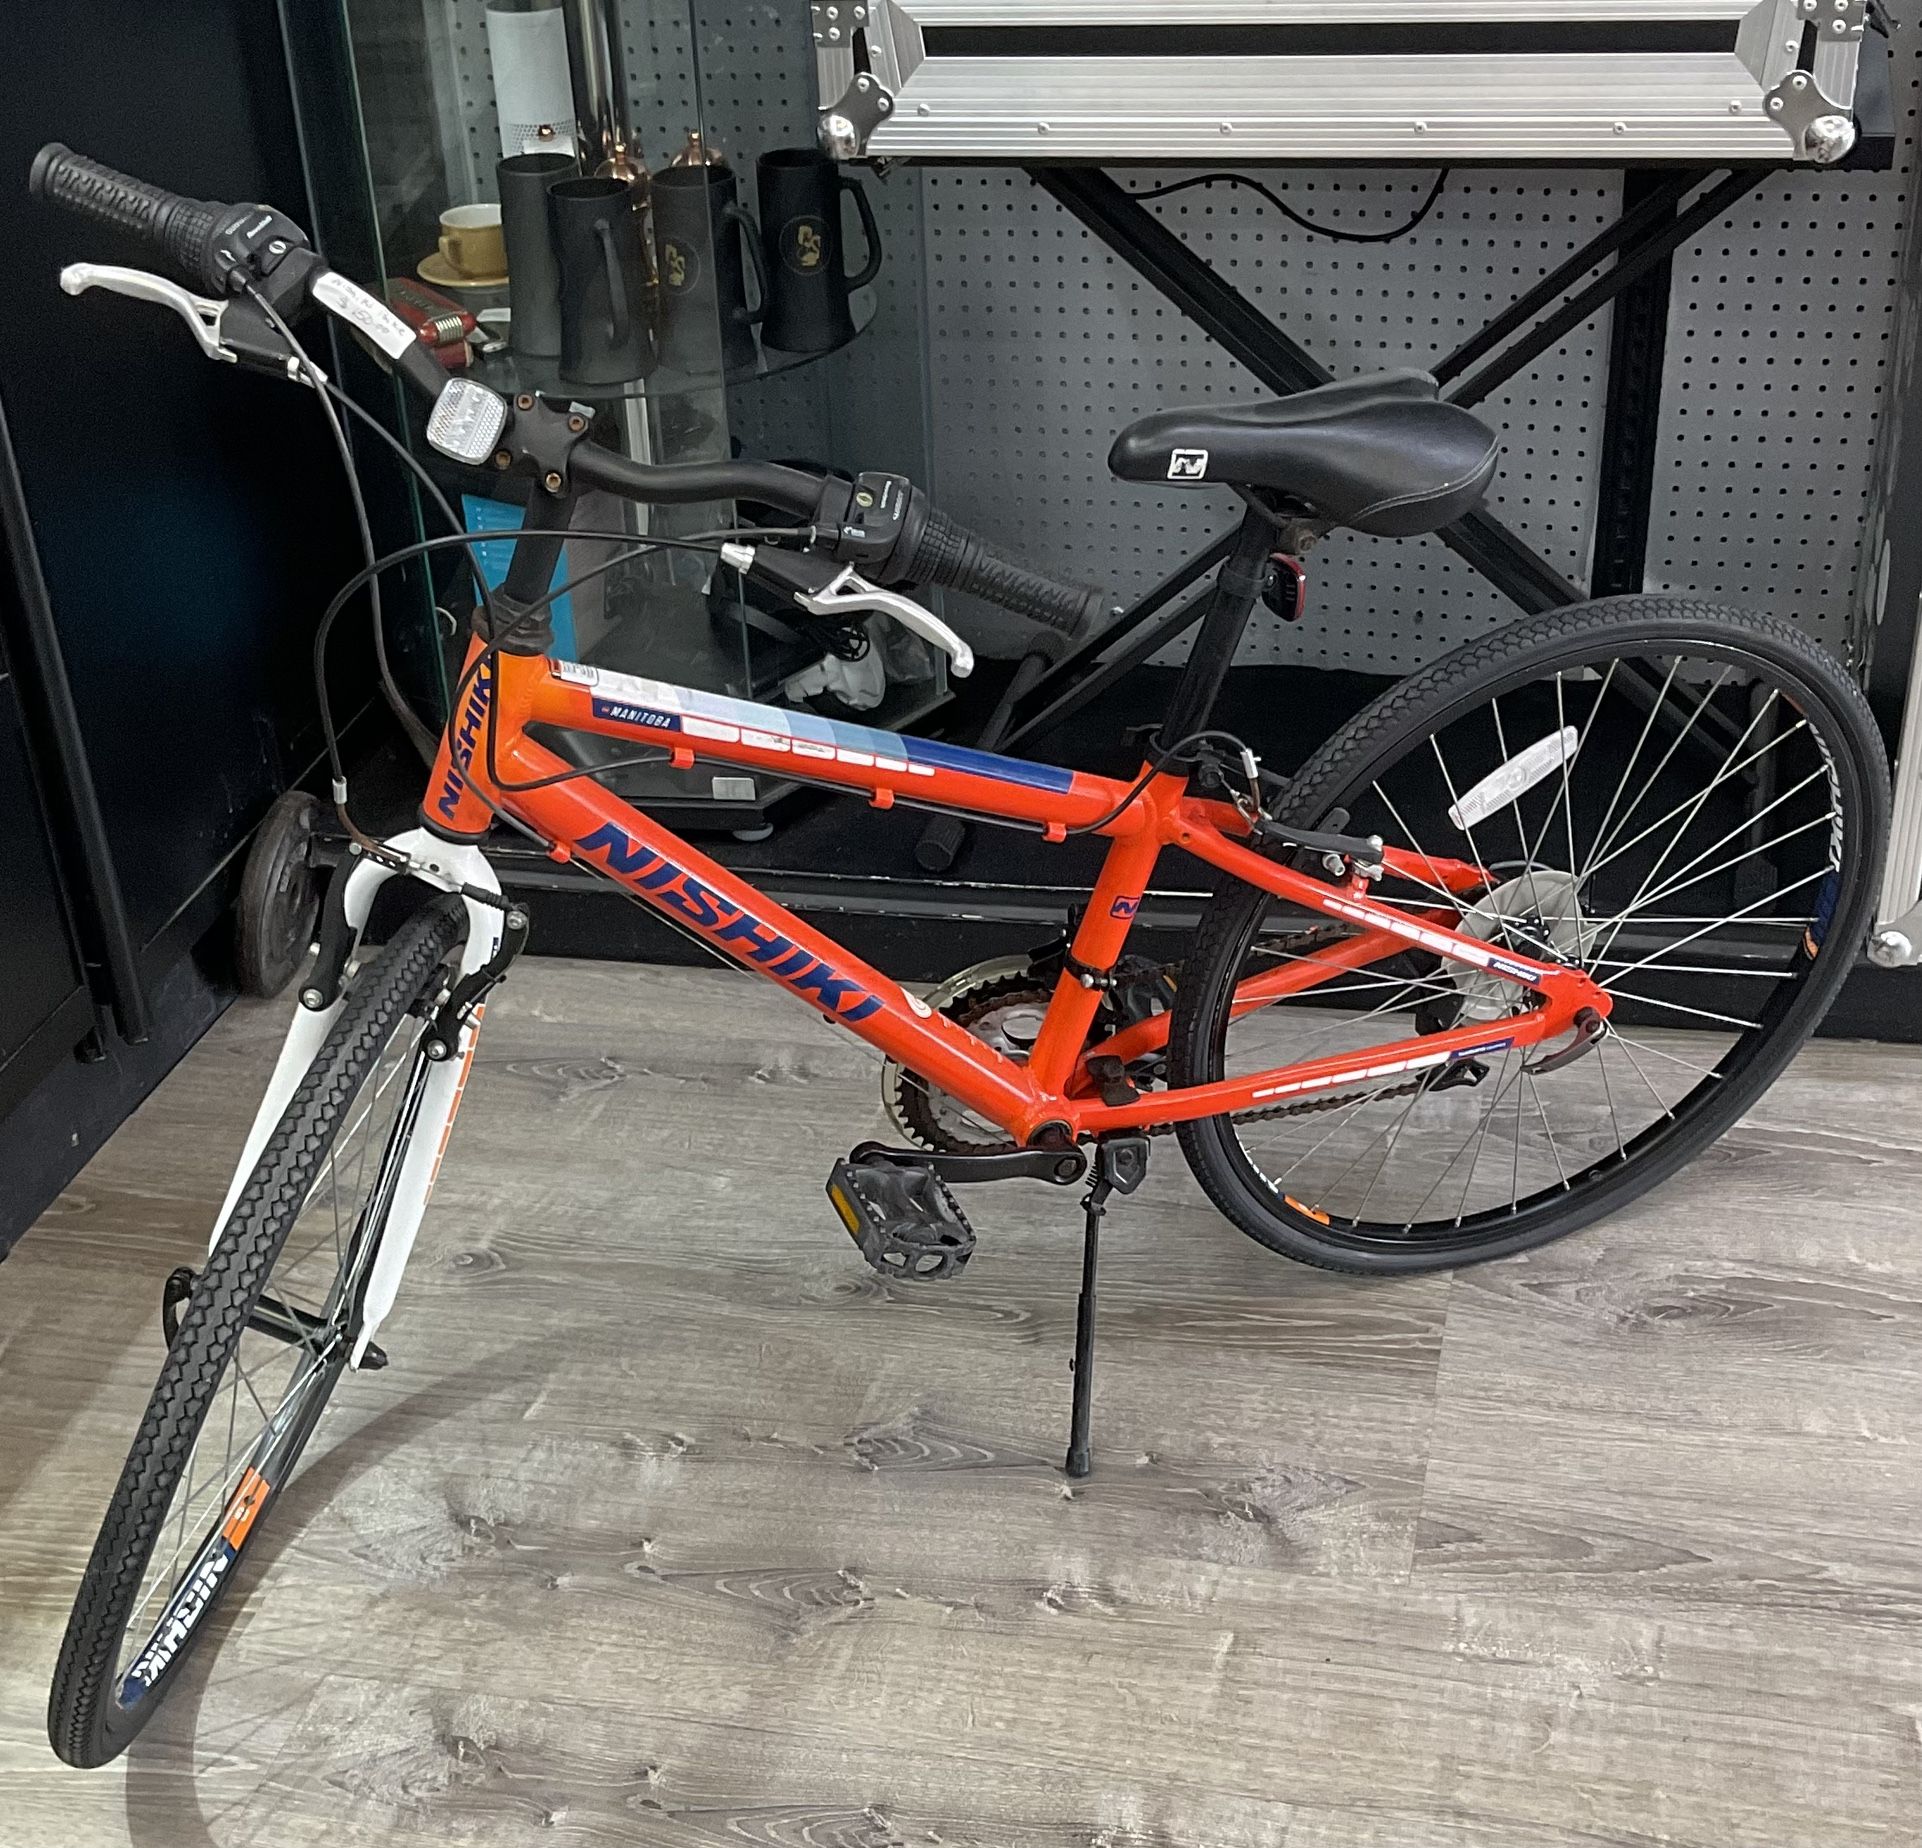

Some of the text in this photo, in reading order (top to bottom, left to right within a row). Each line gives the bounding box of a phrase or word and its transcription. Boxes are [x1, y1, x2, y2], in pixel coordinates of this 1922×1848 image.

[438, 653, 492, 821] NISHIK
[610, 706, 672, 729] MANITOBA
[573, 821, 886, 1023] NISHIKI
